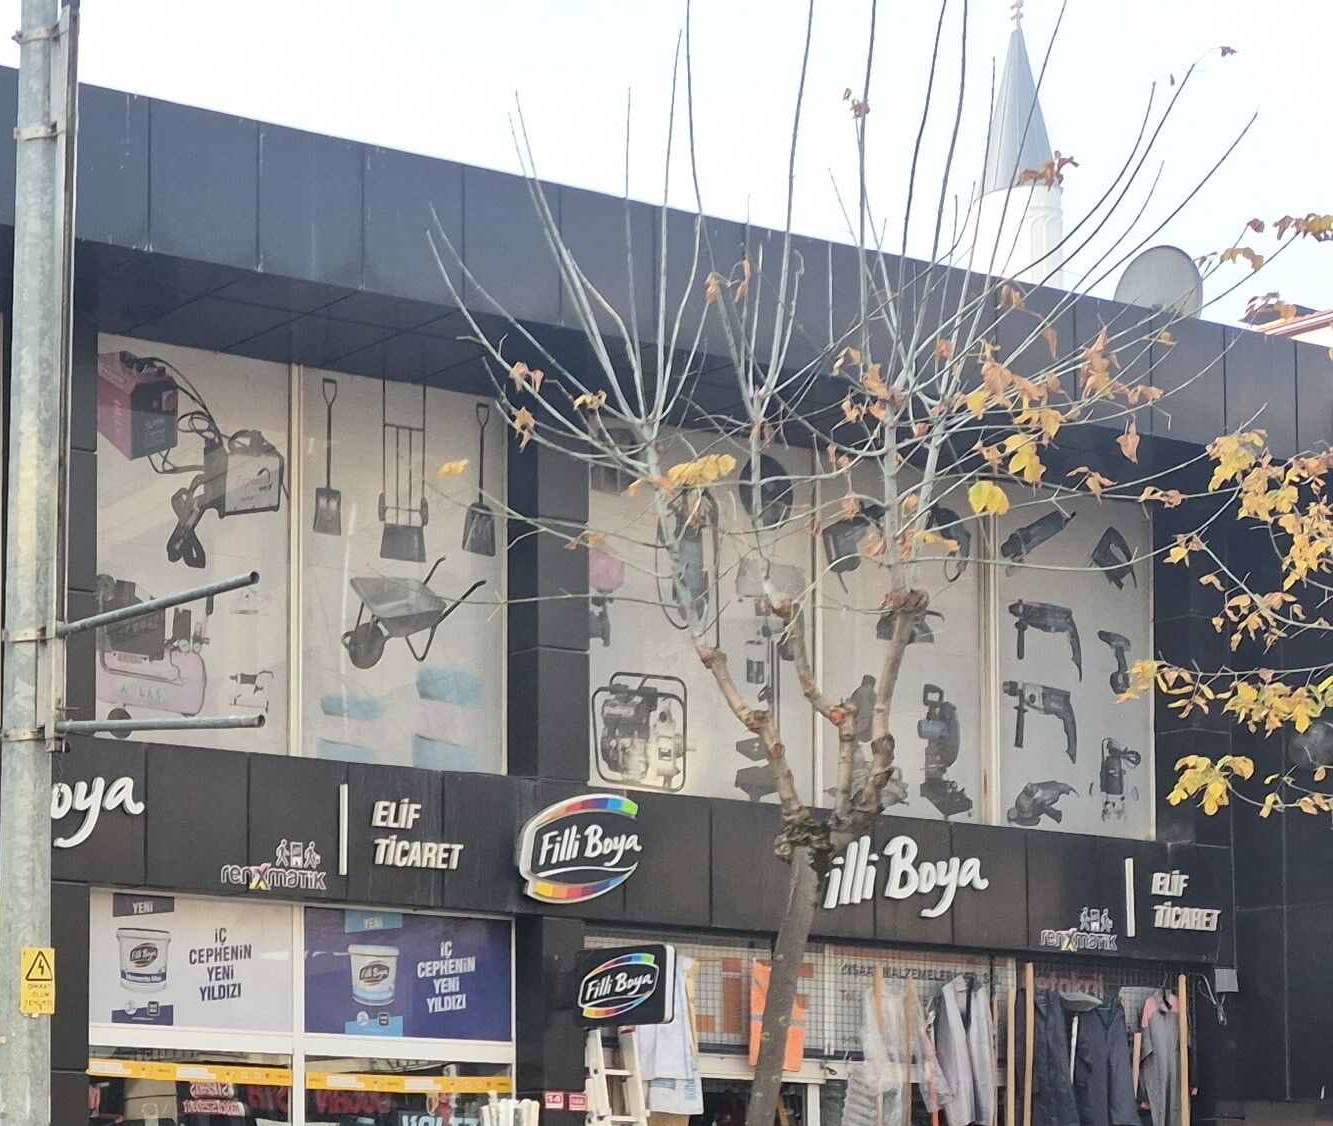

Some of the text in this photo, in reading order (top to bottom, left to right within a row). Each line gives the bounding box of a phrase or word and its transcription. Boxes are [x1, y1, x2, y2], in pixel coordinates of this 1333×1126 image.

[50, 776, 145, 848] oya
[371, 798, 422, 829] ELİF
[373, 834, 464, 870] TİCARET
[538, 824, 642, 867] Filli Boya
[823, 835, 989, 918] illi Boya
[1151, 870, 1190, 897] ELİF
[132, 901, 153, 914] YENİ
[1153, 901, 1222, 932] TİCARET
[214, 927, 227, 945] İÇ
[189, 944, 252, 965] CEPHENİN
[440, 941, 453, 959] İÇ
[207, 964, 235, 982] YENİ
[416, 956, 476, 978] CEPHENİN
[199, 982, 242, 1002] YILDIZI
[433, 976, 460, 995] YENİ
[585, 972, 653, 1001] Filli Boya
[426, 993, 466, 1013] YILDIZI
